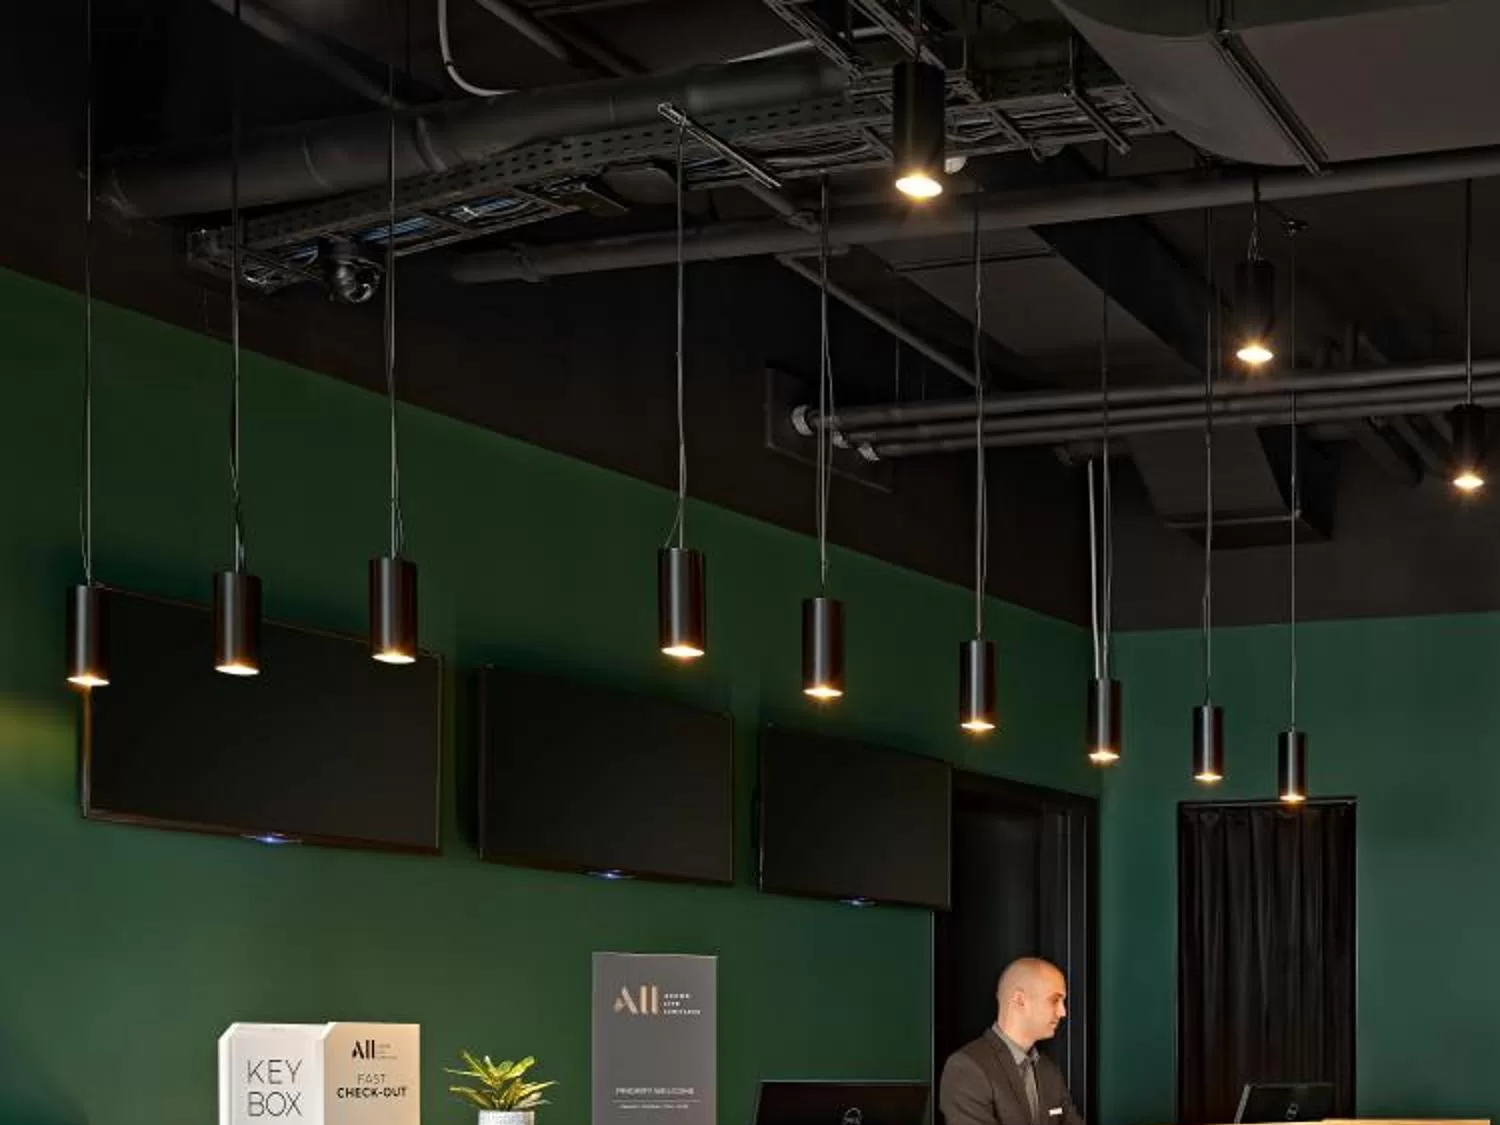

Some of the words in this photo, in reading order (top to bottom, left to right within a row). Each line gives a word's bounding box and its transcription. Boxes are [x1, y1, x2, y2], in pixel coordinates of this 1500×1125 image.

[247, 1059, 303, 1084] KEY
[357, 1073, 386, 1085] FAST
[336, 1086, 408, 1099] CHECK-OUT
[248, 1091, 303, 1117] BOX
